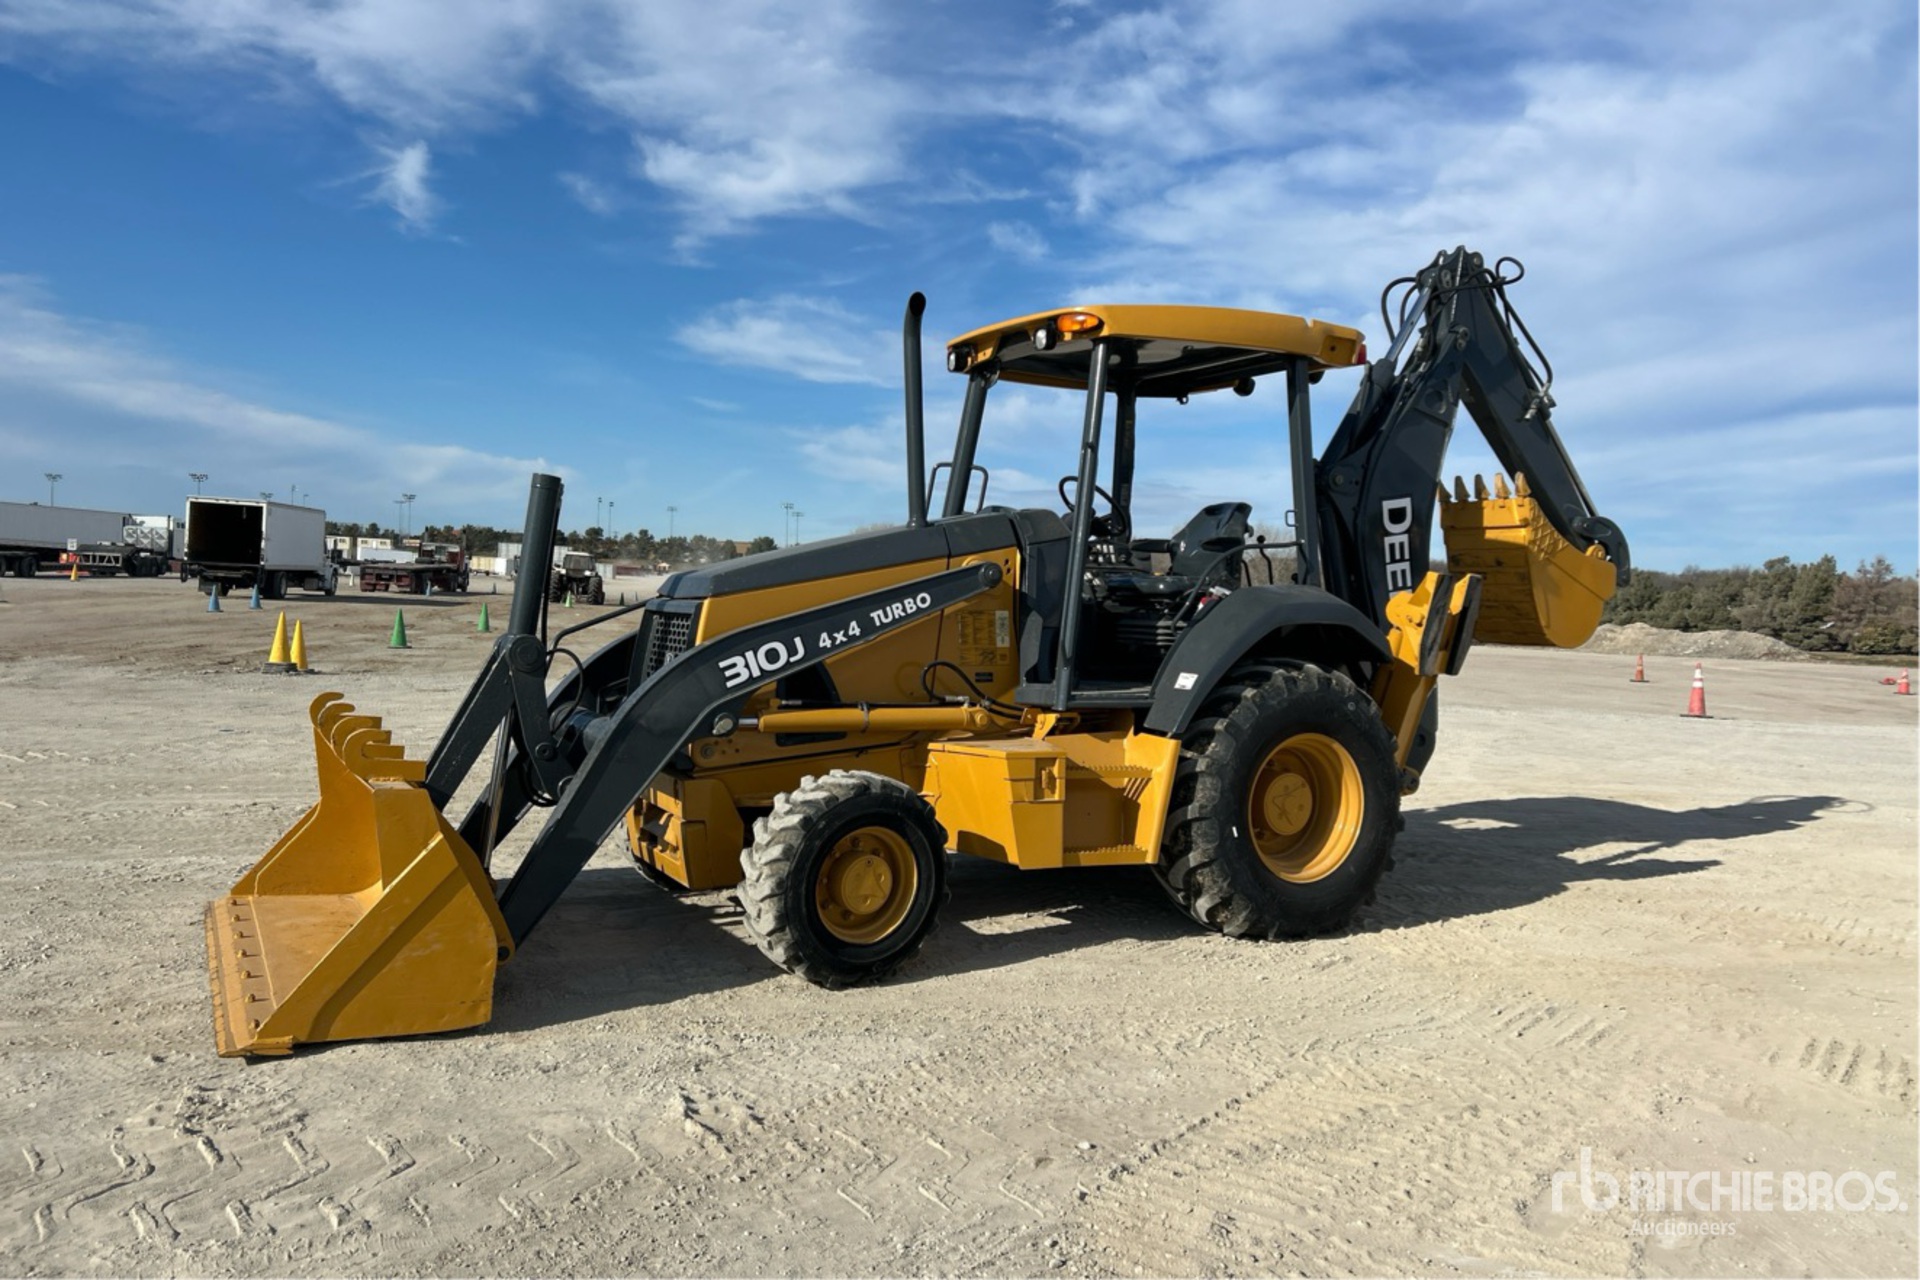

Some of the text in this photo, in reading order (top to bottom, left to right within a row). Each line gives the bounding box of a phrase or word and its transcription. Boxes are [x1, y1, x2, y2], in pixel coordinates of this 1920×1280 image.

[1382, 497, 1413, 600] DEE
[718, 592, 931, 688] 310J 4x4 TURBO
